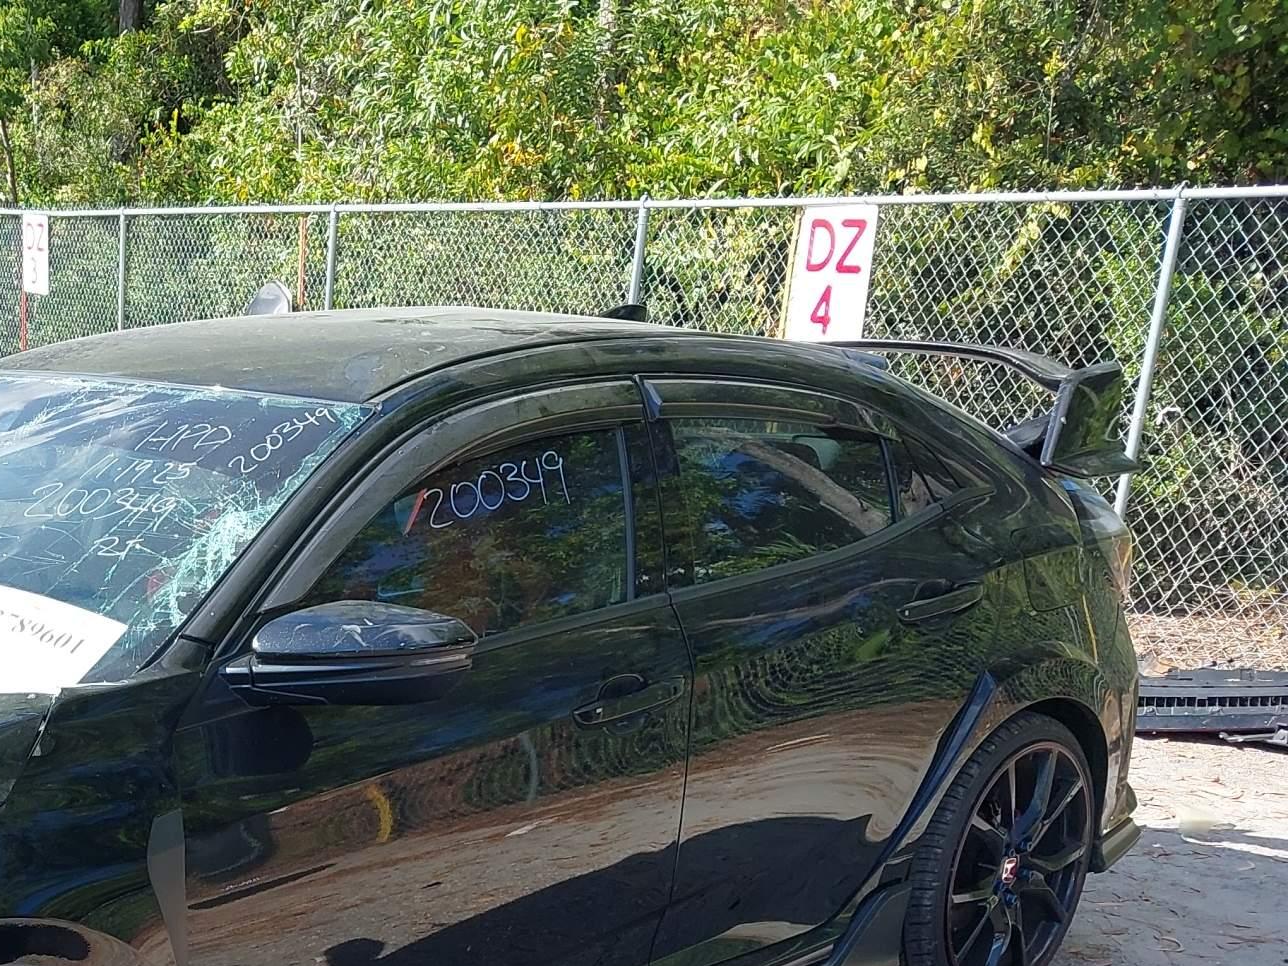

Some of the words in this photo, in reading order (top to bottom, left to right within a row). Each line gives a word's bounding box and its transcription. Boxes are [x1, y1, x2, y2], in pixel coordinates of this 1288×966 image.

[805, 218, 868, 274] DZ
[809, 284, 833, 336] 4
[134, 421, 233, 452] HPD
[227, 406, 337, 474] 200349
[24, 482, 177, 533] 200349
[422, 450, 572, 530] 200349
